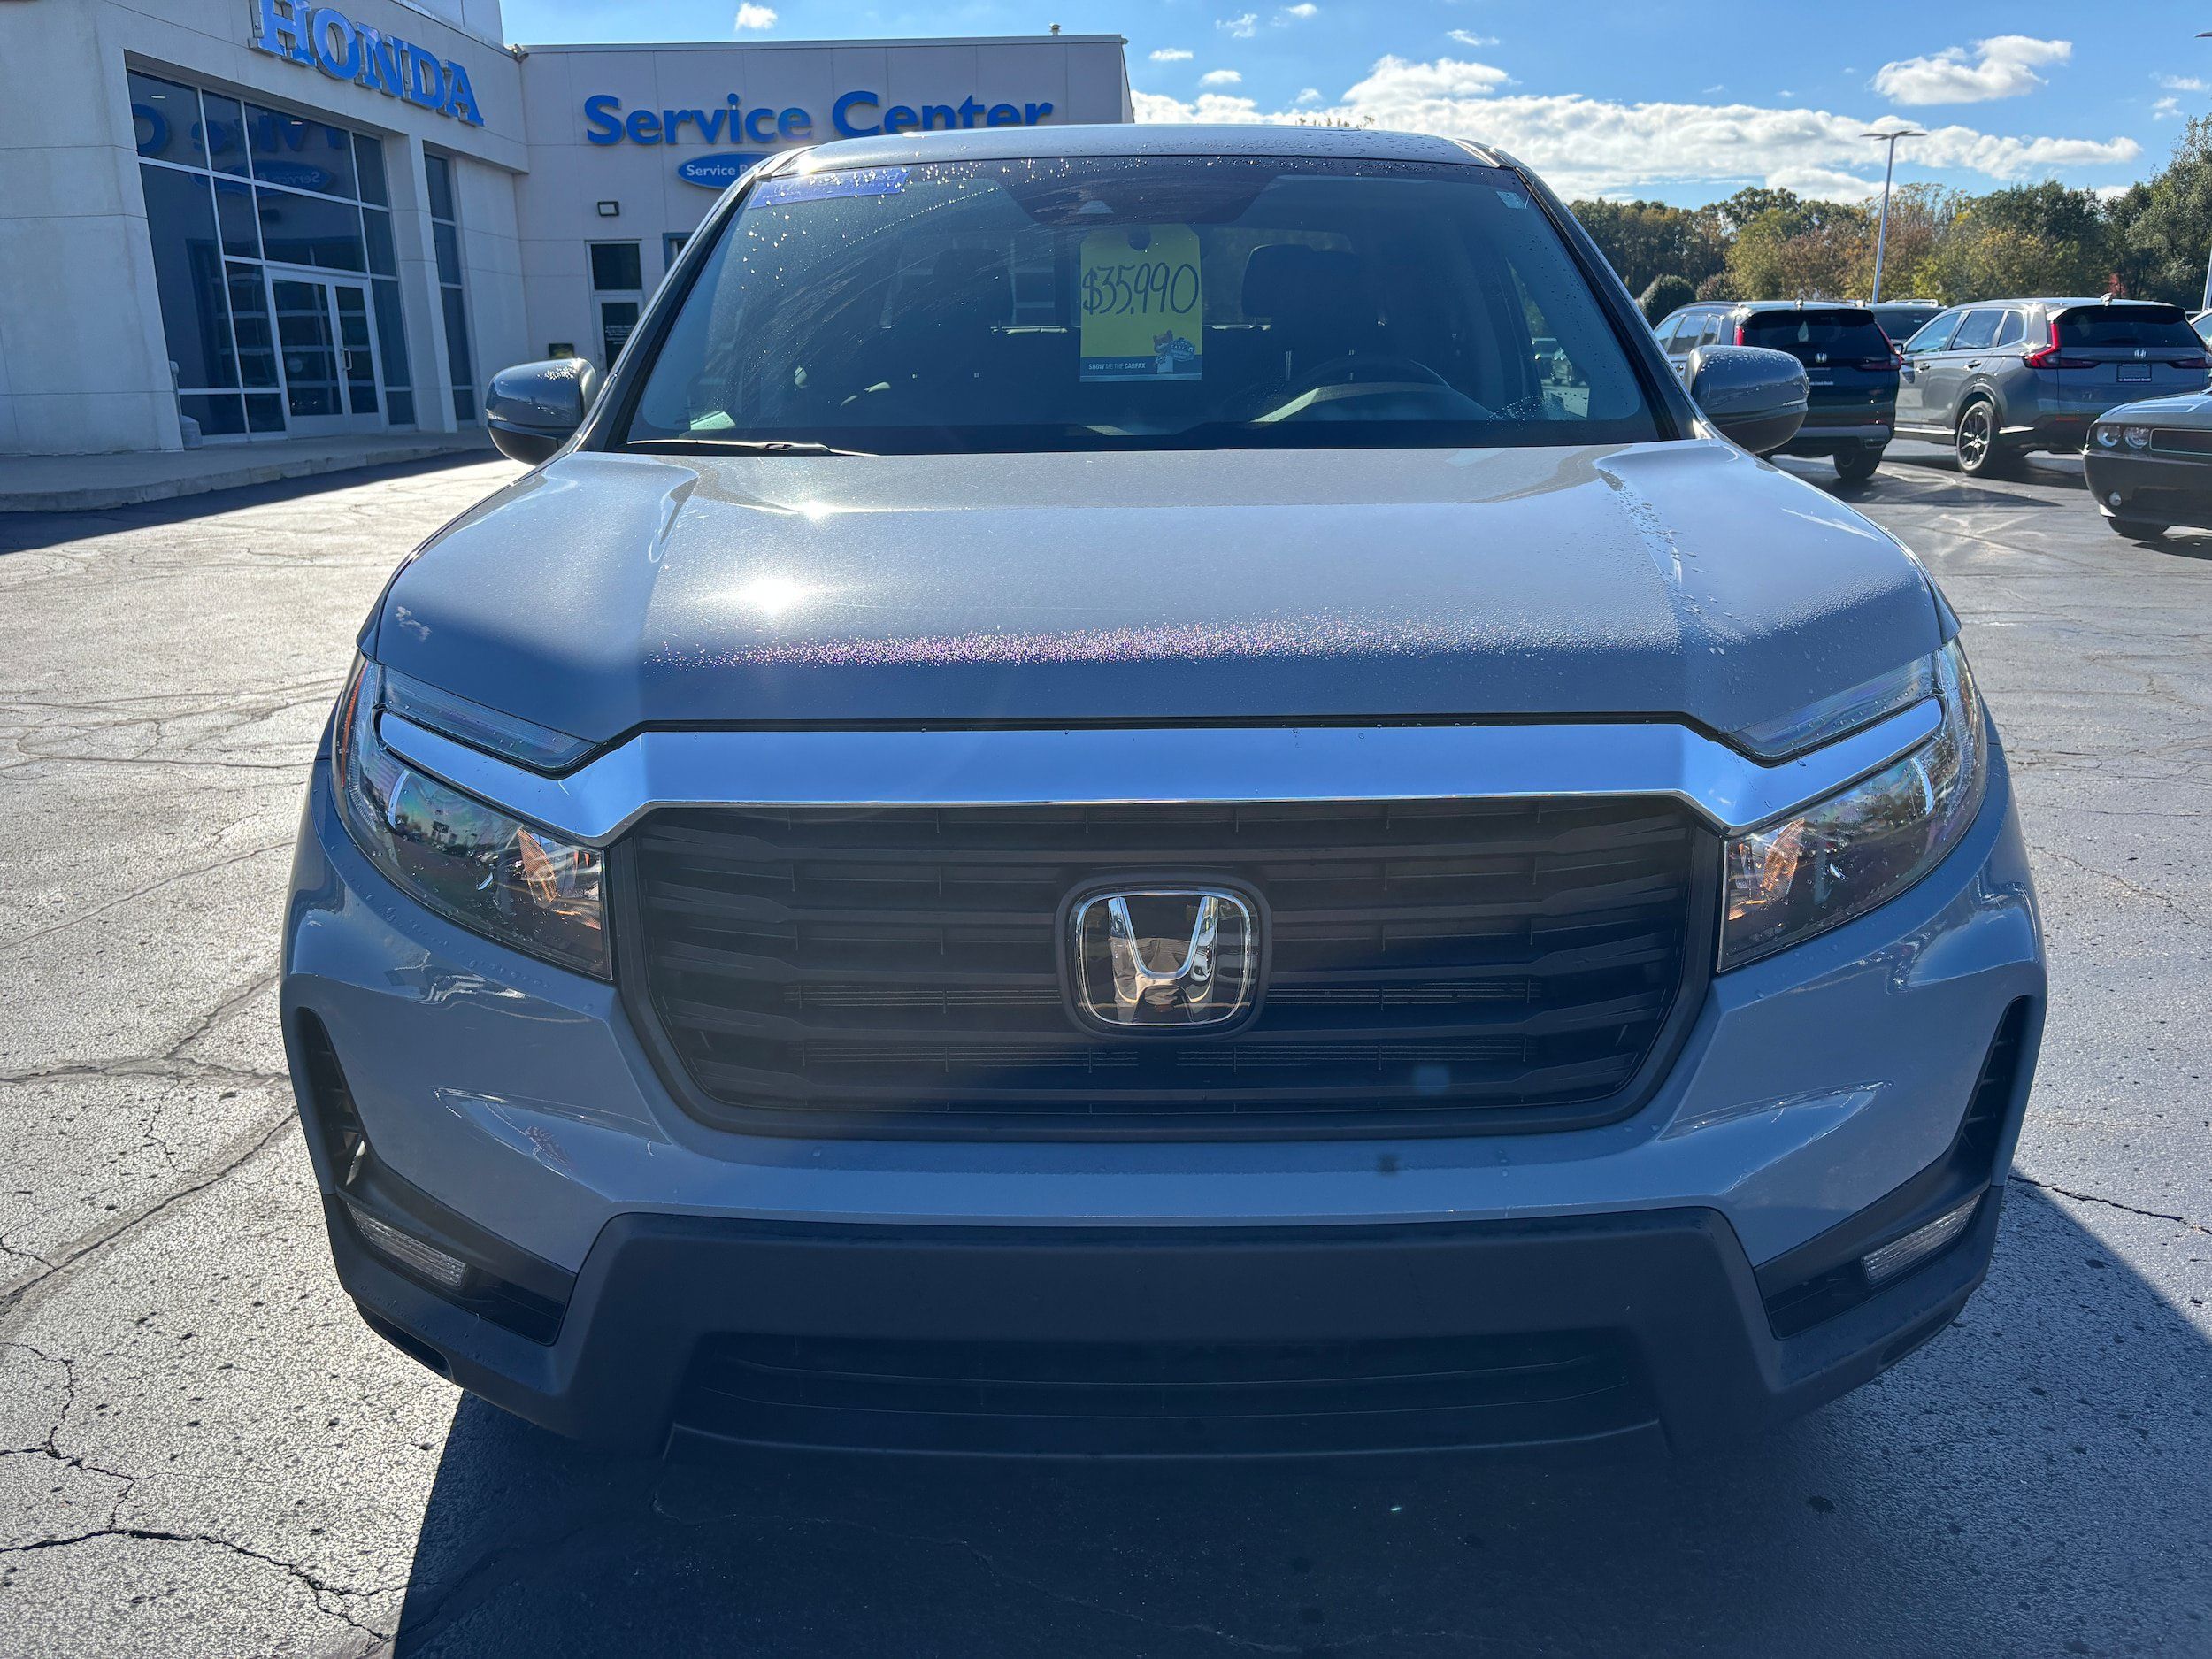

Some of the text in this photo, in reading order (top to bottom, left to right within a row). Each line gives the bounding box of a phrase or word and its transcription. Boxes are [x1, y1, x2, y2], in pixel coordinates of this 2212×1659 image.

[251, 0, 484, 127] HONDA
[584, 90, 1054, 145] Service Center
[686, 165, 735, 176] Service
